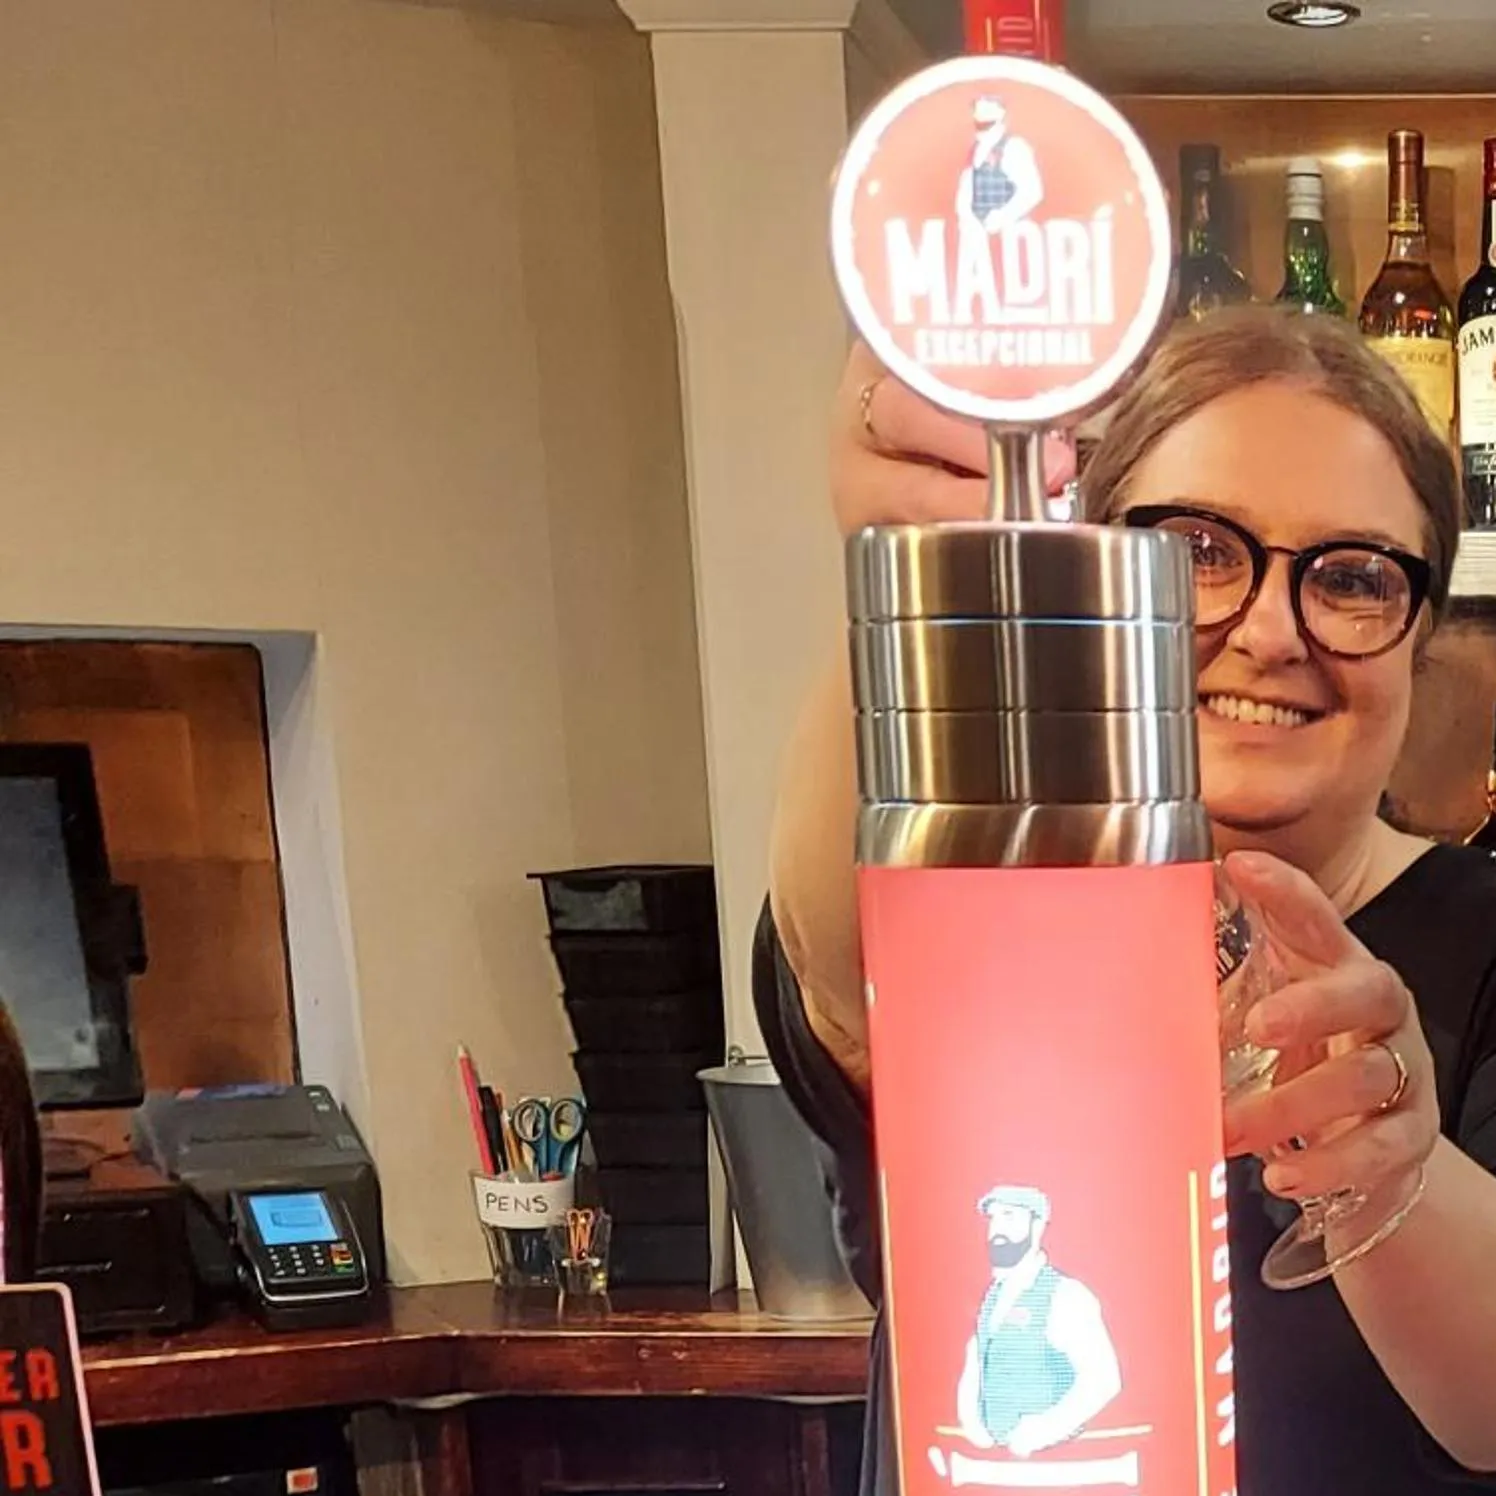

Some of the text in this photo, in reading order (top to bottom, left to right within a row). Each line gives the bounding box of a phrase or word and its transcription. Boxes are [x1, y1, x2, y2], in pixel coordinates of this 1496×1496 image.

[885, 204, 1115, 325] MADRÍ
[915, 329, 1093, 367] EXCEPCIONAL
[486, 1192, 549, 1213] PENS
